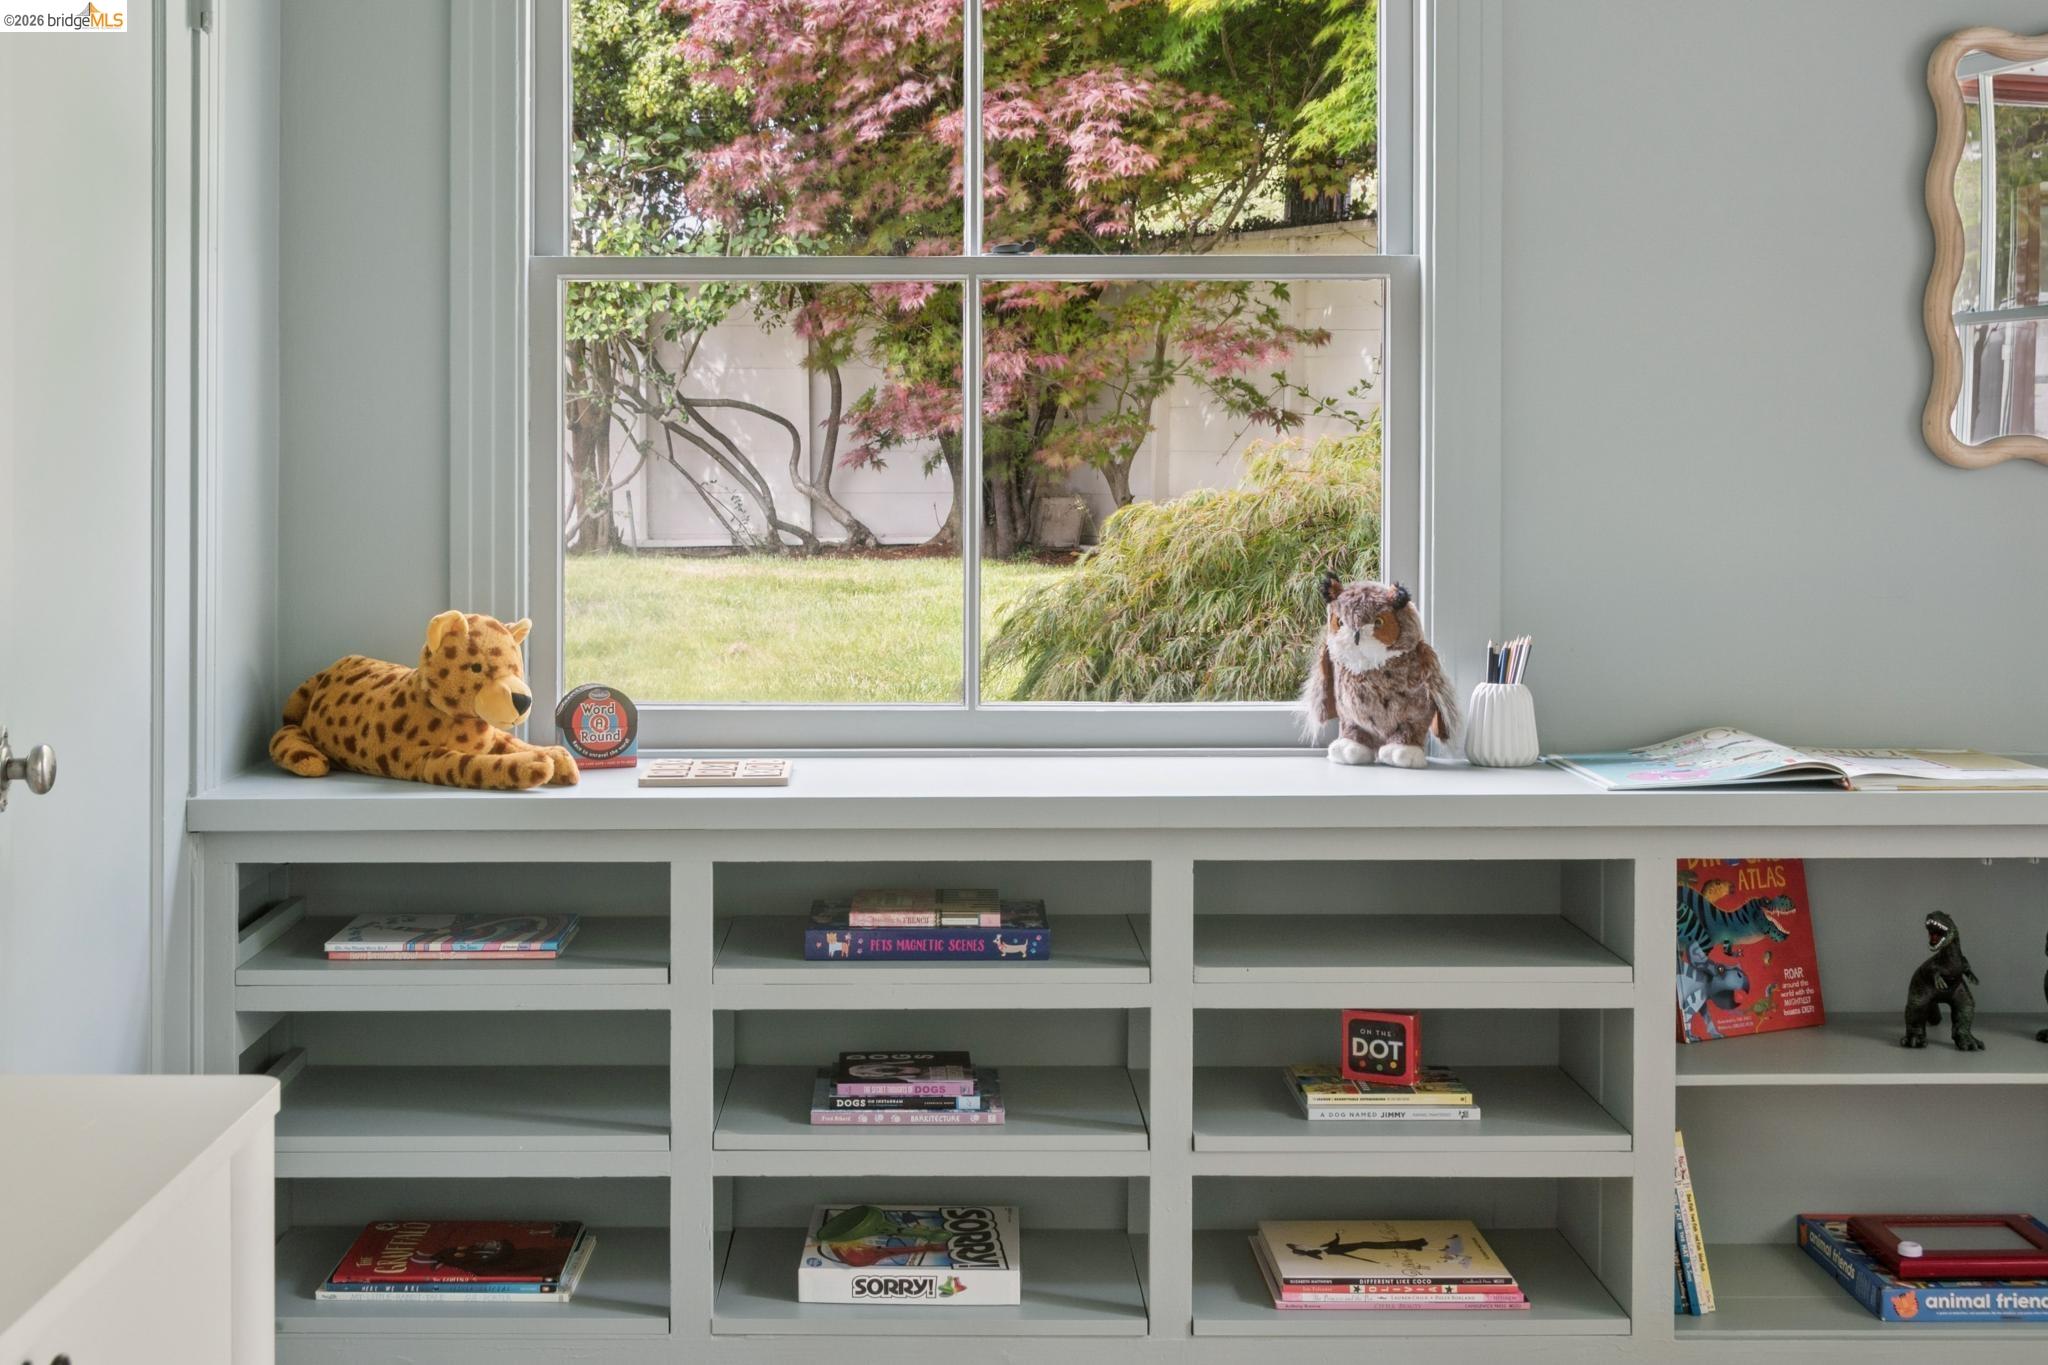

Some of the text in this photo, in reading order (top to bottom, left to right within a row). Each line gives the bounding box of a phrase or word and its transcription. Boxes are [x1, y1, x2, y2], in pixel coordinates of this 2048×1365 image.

[581, 702, 616, 714] Word
[580, 730, 622, 743] Round
[1738, 866, 1786, 890] ATLAS
[870, 938, 984, 951] PETS MAGNETIC SCENES
[1784, 967, 1804, 980] ROAR
[1352, 1037, 1403, 1060] DOT
[914, 1086, 946, 1094] DOGS
[946, 1208, 1001, 1268] SORRY!
[1809, 1232, 1856, 1280] animal friends
[854, 1278, 934, 1296] SORRY!
[1925, 1293, 1990, 1309] animal
